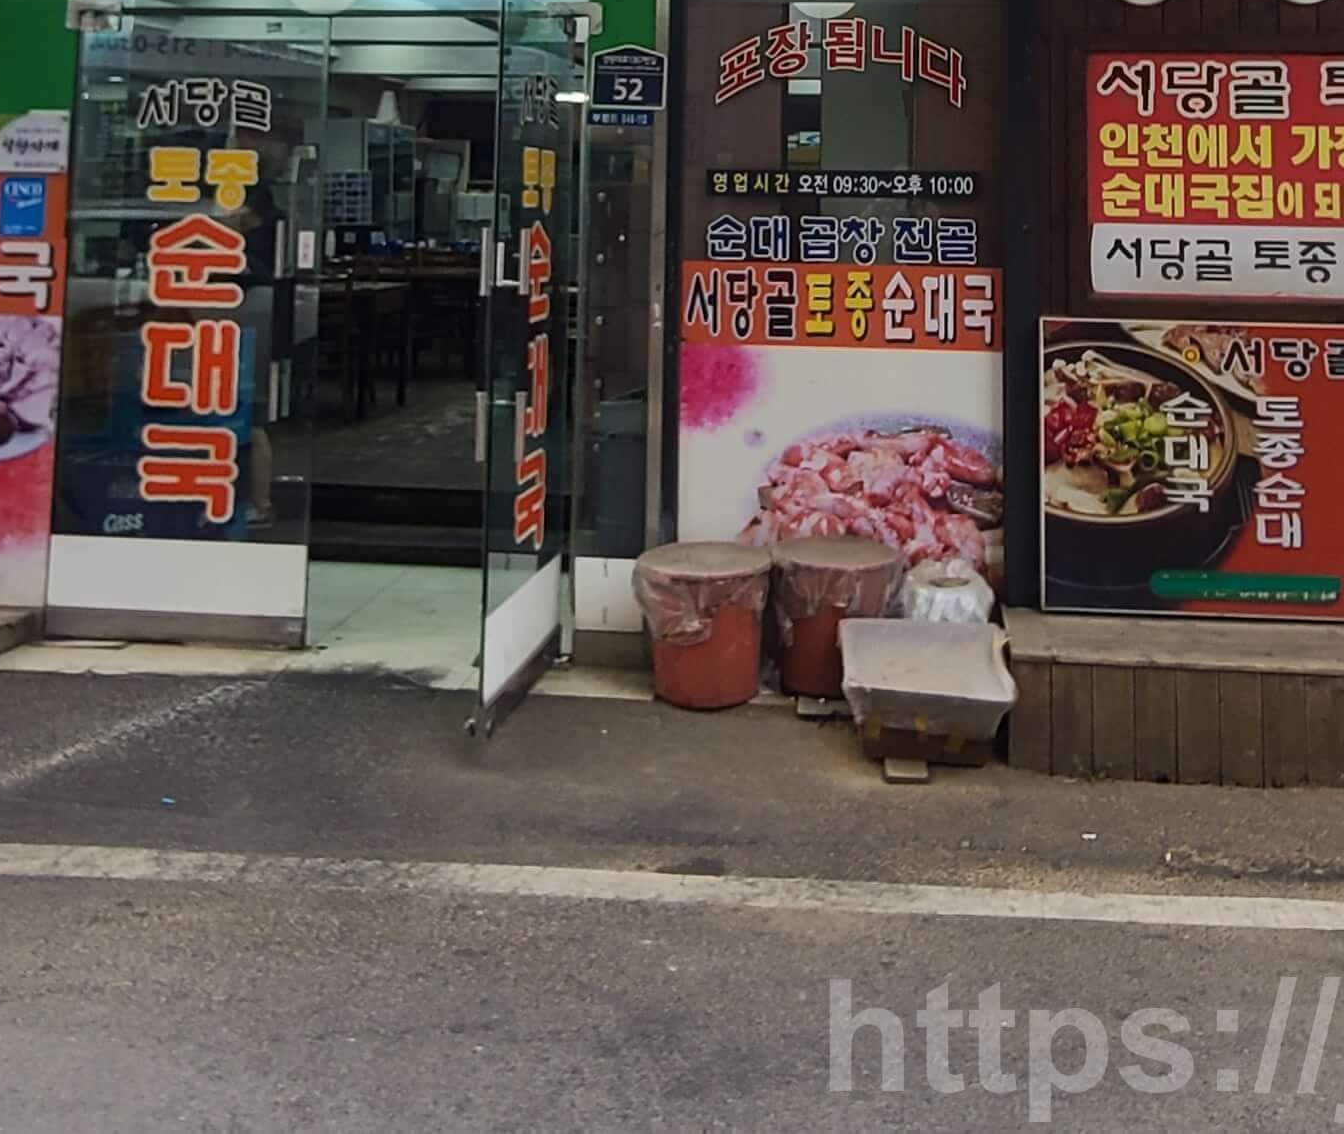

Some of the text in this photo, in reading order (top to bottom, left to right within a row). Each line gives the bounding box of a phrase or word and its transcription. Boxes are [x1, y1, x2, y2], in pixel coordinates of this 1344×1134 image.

[137, 77, 271, 132] 서당골
[612, 78, 643, 100] 52
[1097, 60, 1290, 119] 서당골
[1099, 123, 1273, 168] 인천에서
[146, 146, 259, 210] 토종
[798, 174, 828, 194] 오전
[929, 176, 974, 195] 10:00
[1100, 174, 1304, 220] 순대국집이
[706, 214, 977, 265] 순대 곱창 전골
[1106, 237, 1233, 282] 서당골
[1254, 238, 1337, 285] 토종
[685, 267, 995, 345] 서당골 토종 순대국
[136, 213, 247, 524] 순대국
[1162, 390, 1215, 513] 순대국
[1252, 395, 1306, 549] 토종순대
